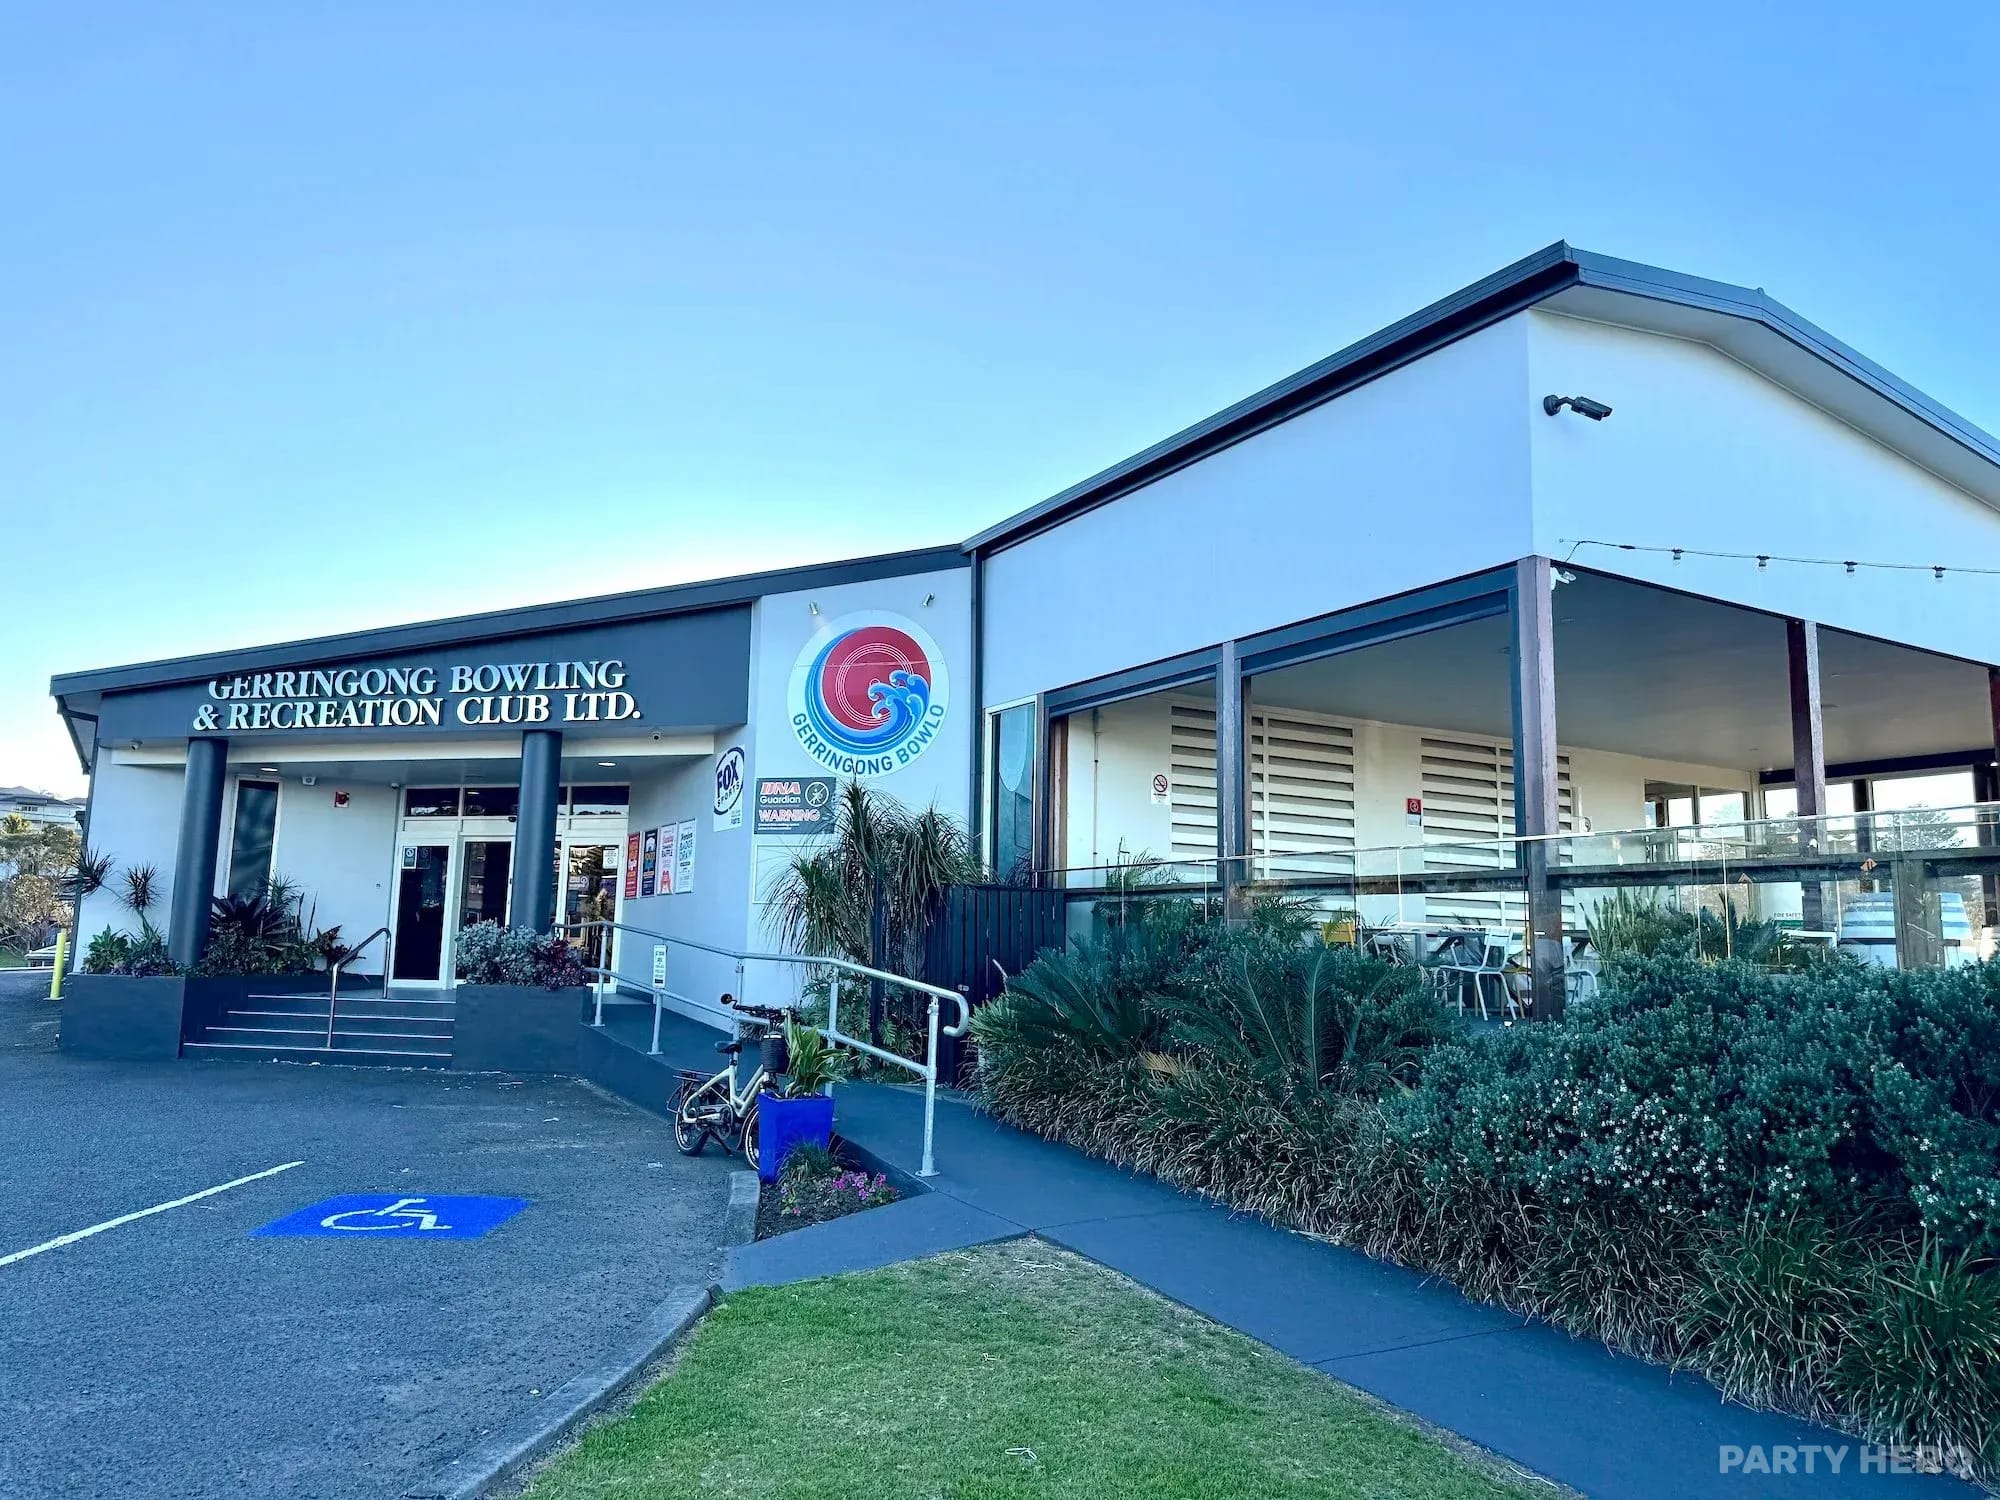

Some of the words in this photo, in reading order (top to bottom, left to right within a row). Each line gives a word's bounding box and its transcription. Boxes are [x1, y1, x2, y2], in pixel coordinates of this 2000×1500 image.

[208, 667, 437, 700] GERRINGONG
[449, 660, 626, 693] BOWLING
[193, 703, 218, 731] &
[227, 697, 443, 730] RECREATION
[456, 694, 550, 725] CLUB
[563, 691, 641, 721] LTD.
[792, 712, 894, 776] GERRINGONG
[895, 704, 944, 764] BOWLO
[717, 755, 739, 798] FOX
[760, 782, 801, 795] DNA
[718, 781, 740, 808] SPORTS
[760, 796, 801, 804] Guardian
[758, 809, 820, 822] WARNING
